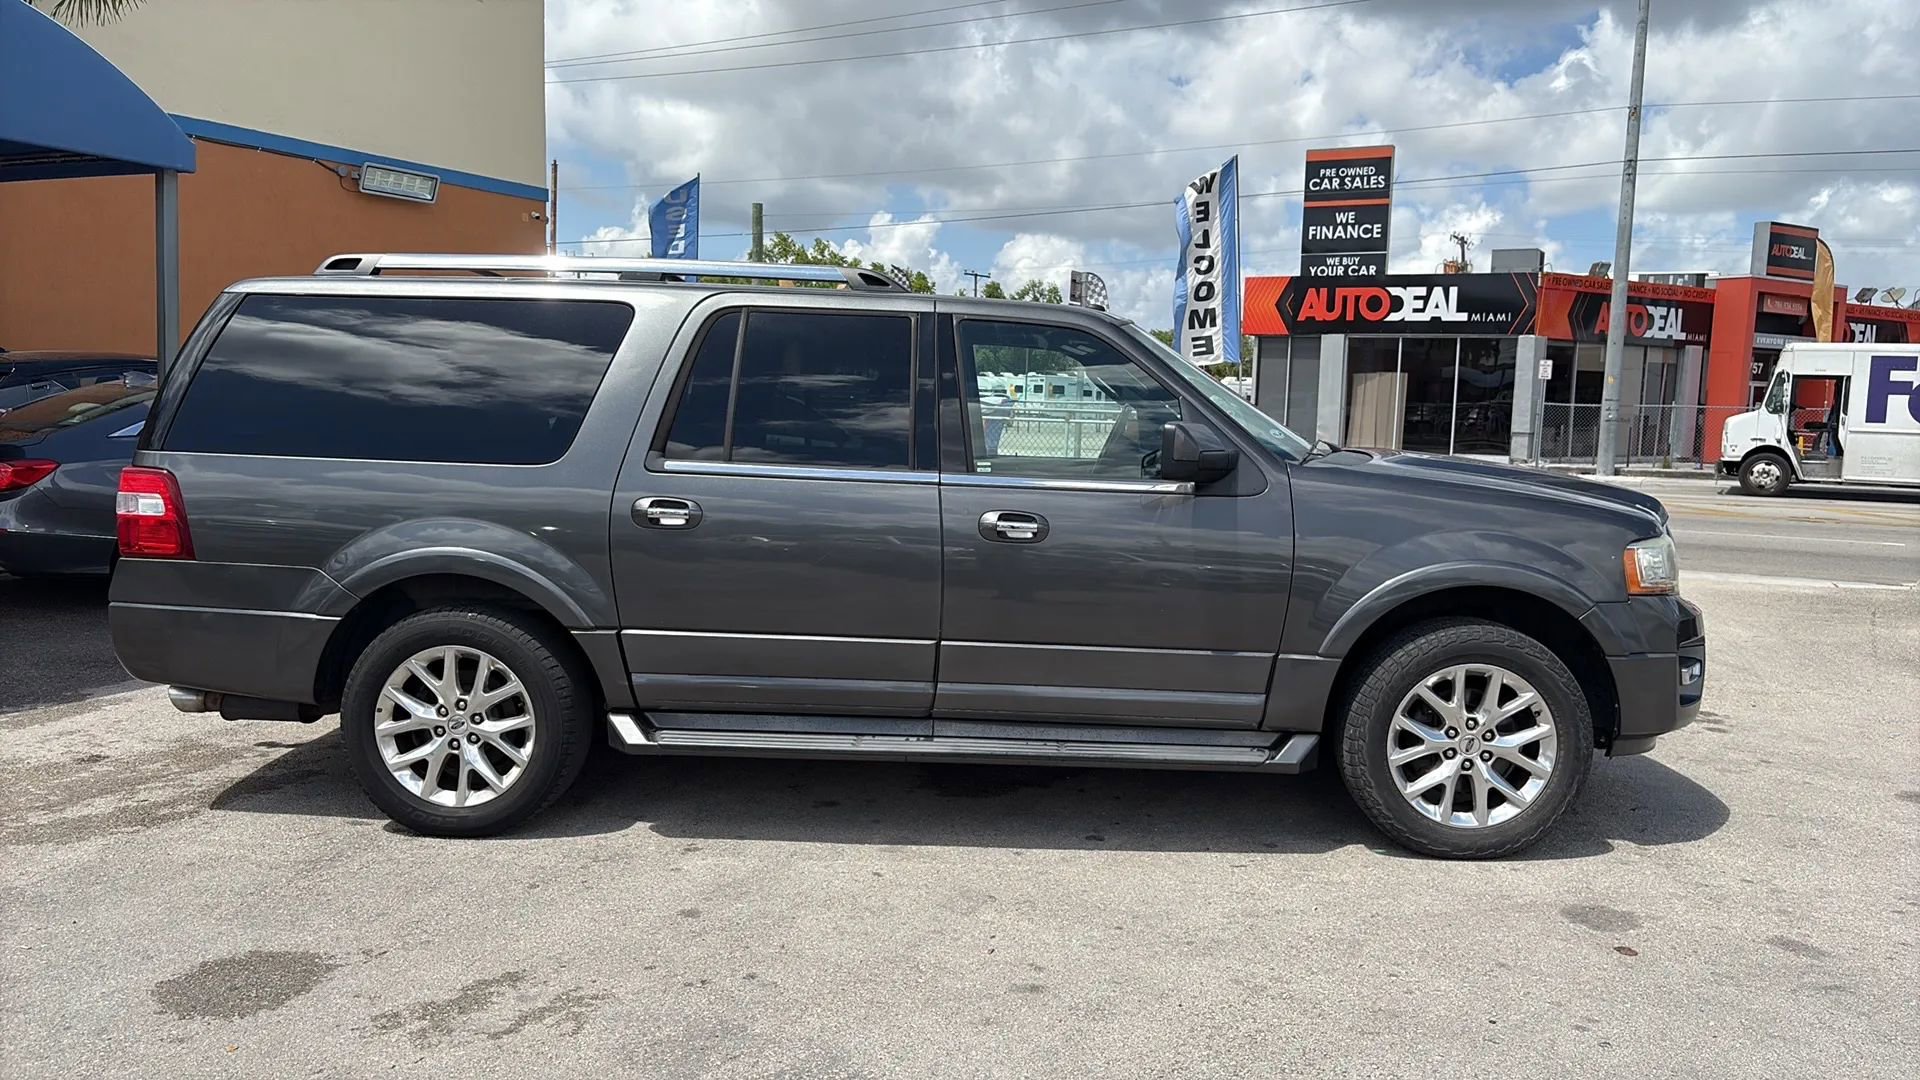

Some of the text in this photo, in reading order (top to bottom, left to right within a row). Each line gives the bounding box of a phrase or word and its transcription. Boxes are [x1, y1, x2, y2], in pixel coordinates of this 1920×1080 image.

[1319, 166, 1376, 177] PRE OWNED
[1309, 175, 1385, 191] CAR SALES
[1335, 211, 1356, 224] WE
[1308, 223, 1382, 240] FINANCE
[1771, 243, 1806, 260] AUTODEAL
[1326, 256, 1361, 266] WE BUY
[1309, 265, 1377, 277] YOUR CAR
[1297, 286, 1511, 322] AUTODEAL MIAMI
[1594, 301, 1687, 341] ATODEAL
